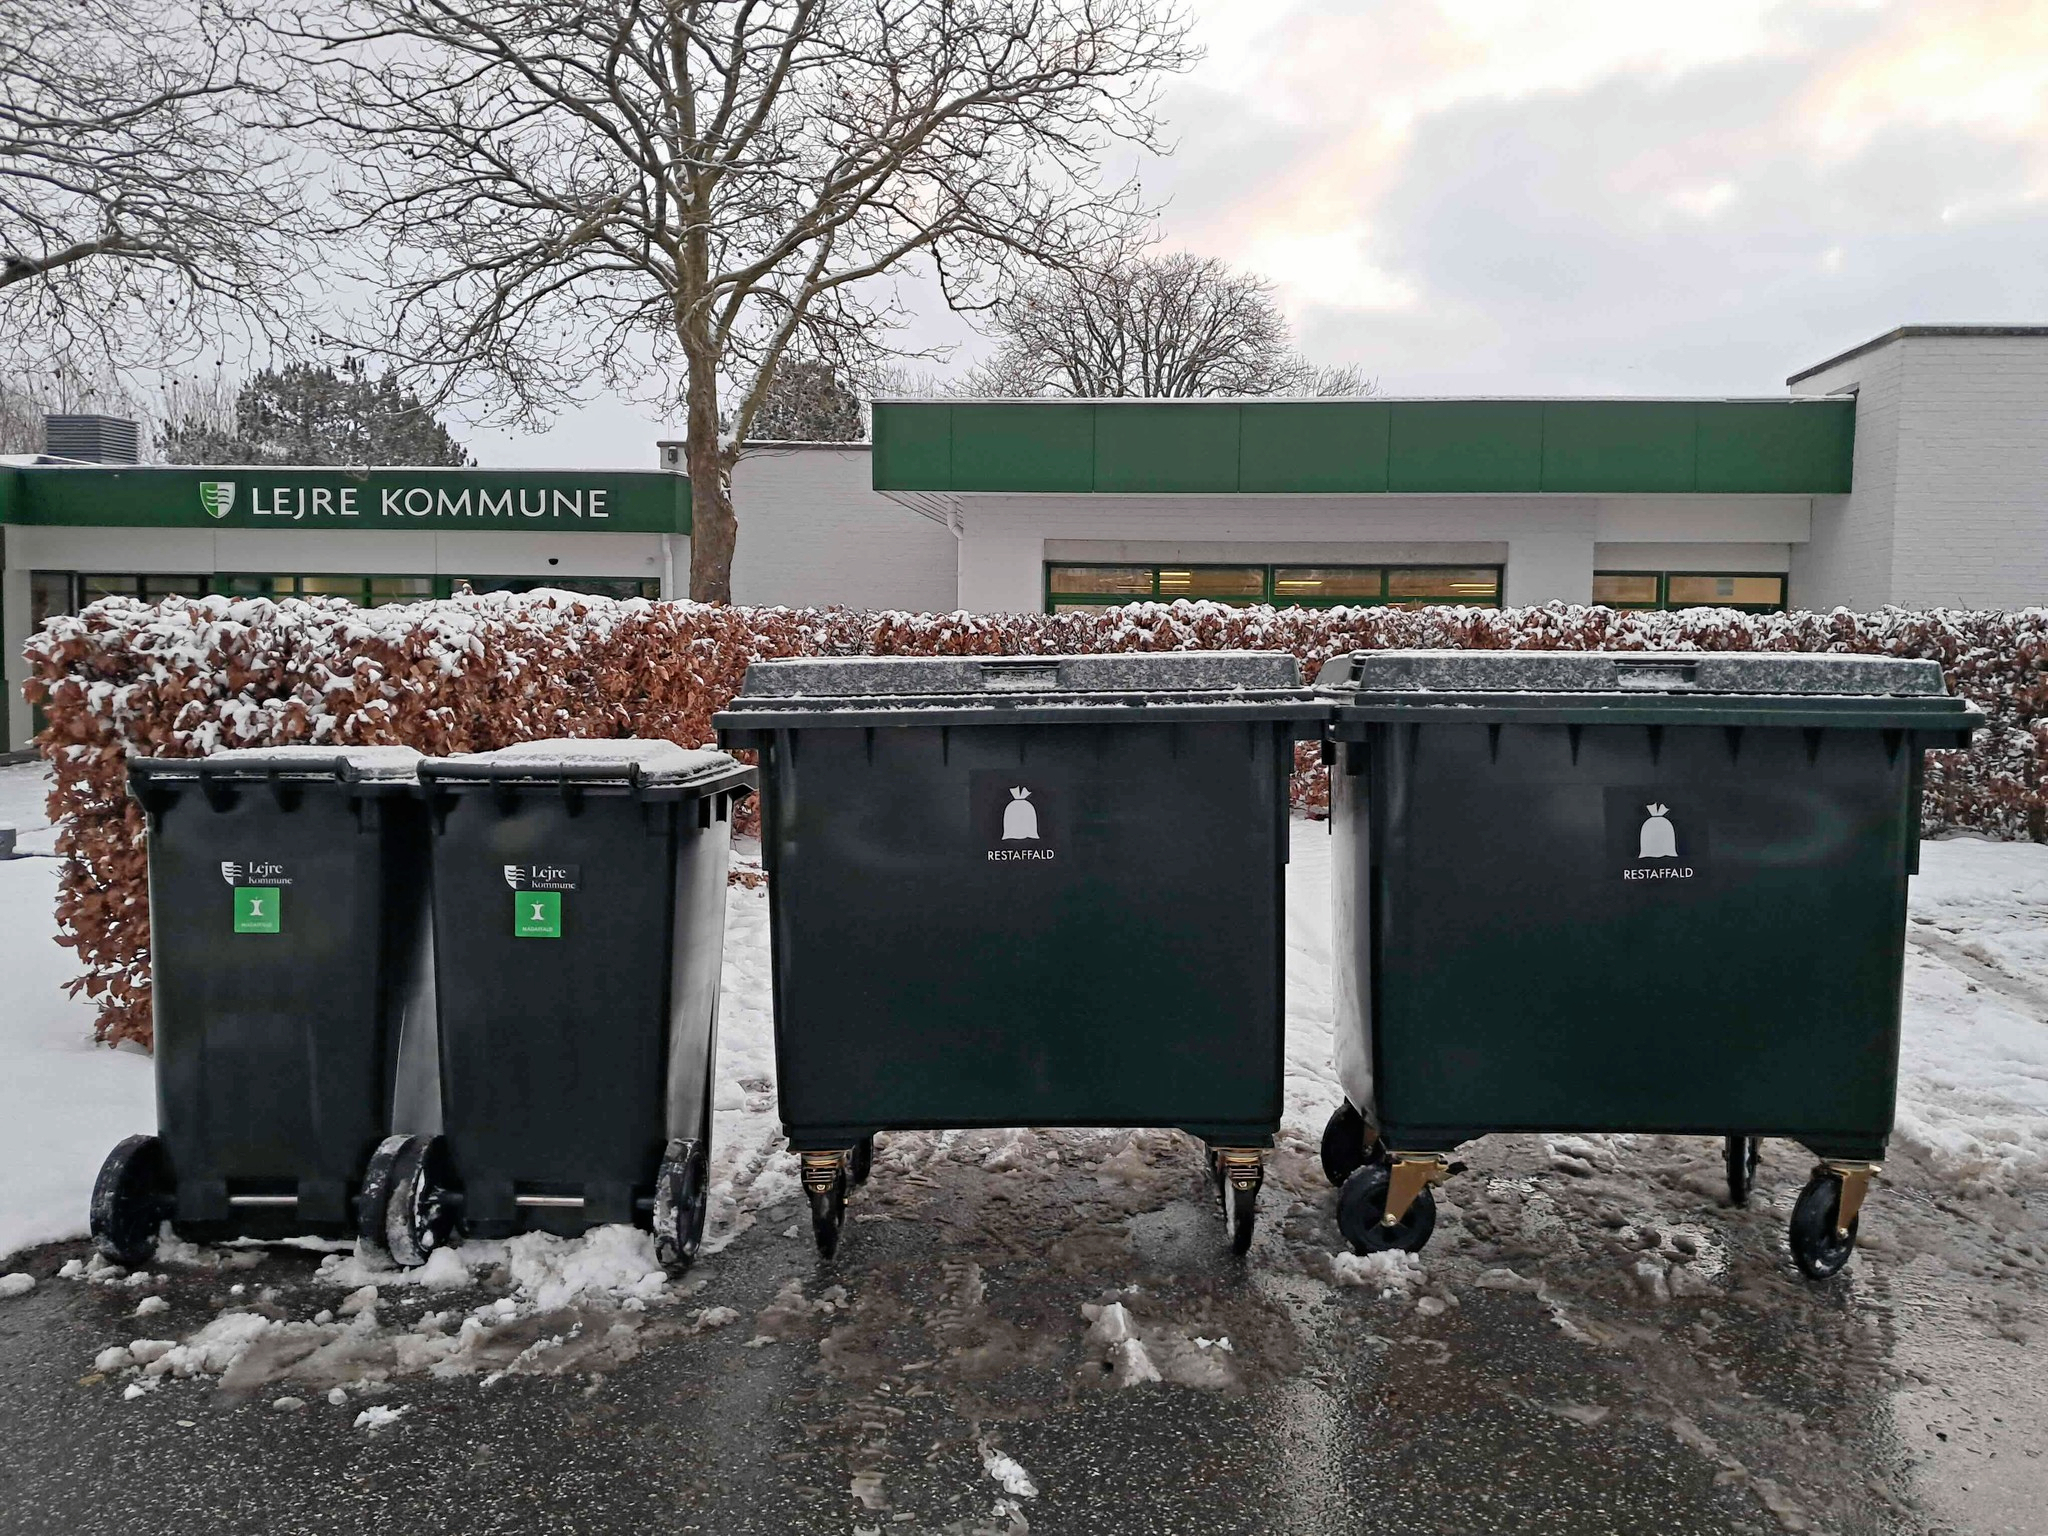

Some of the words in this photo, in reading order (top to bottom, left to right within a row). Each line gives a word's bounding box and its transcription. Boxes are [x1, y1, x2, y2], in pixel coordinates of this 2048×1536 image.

[252, 487, 359, 520] LEJRE
[381, 488, 609, 518] KOMMUNE
[987, 850, 1055, 861] RESTAFFALD
[249, 861, 283, 877] Lejre
[532, 865, 566, 881] Lejre
[1623, 867, 1694, 880] RESTAFFALD
[248, 876, 293, 884] Kommune
[531, 880, 576, 889] Kommune
